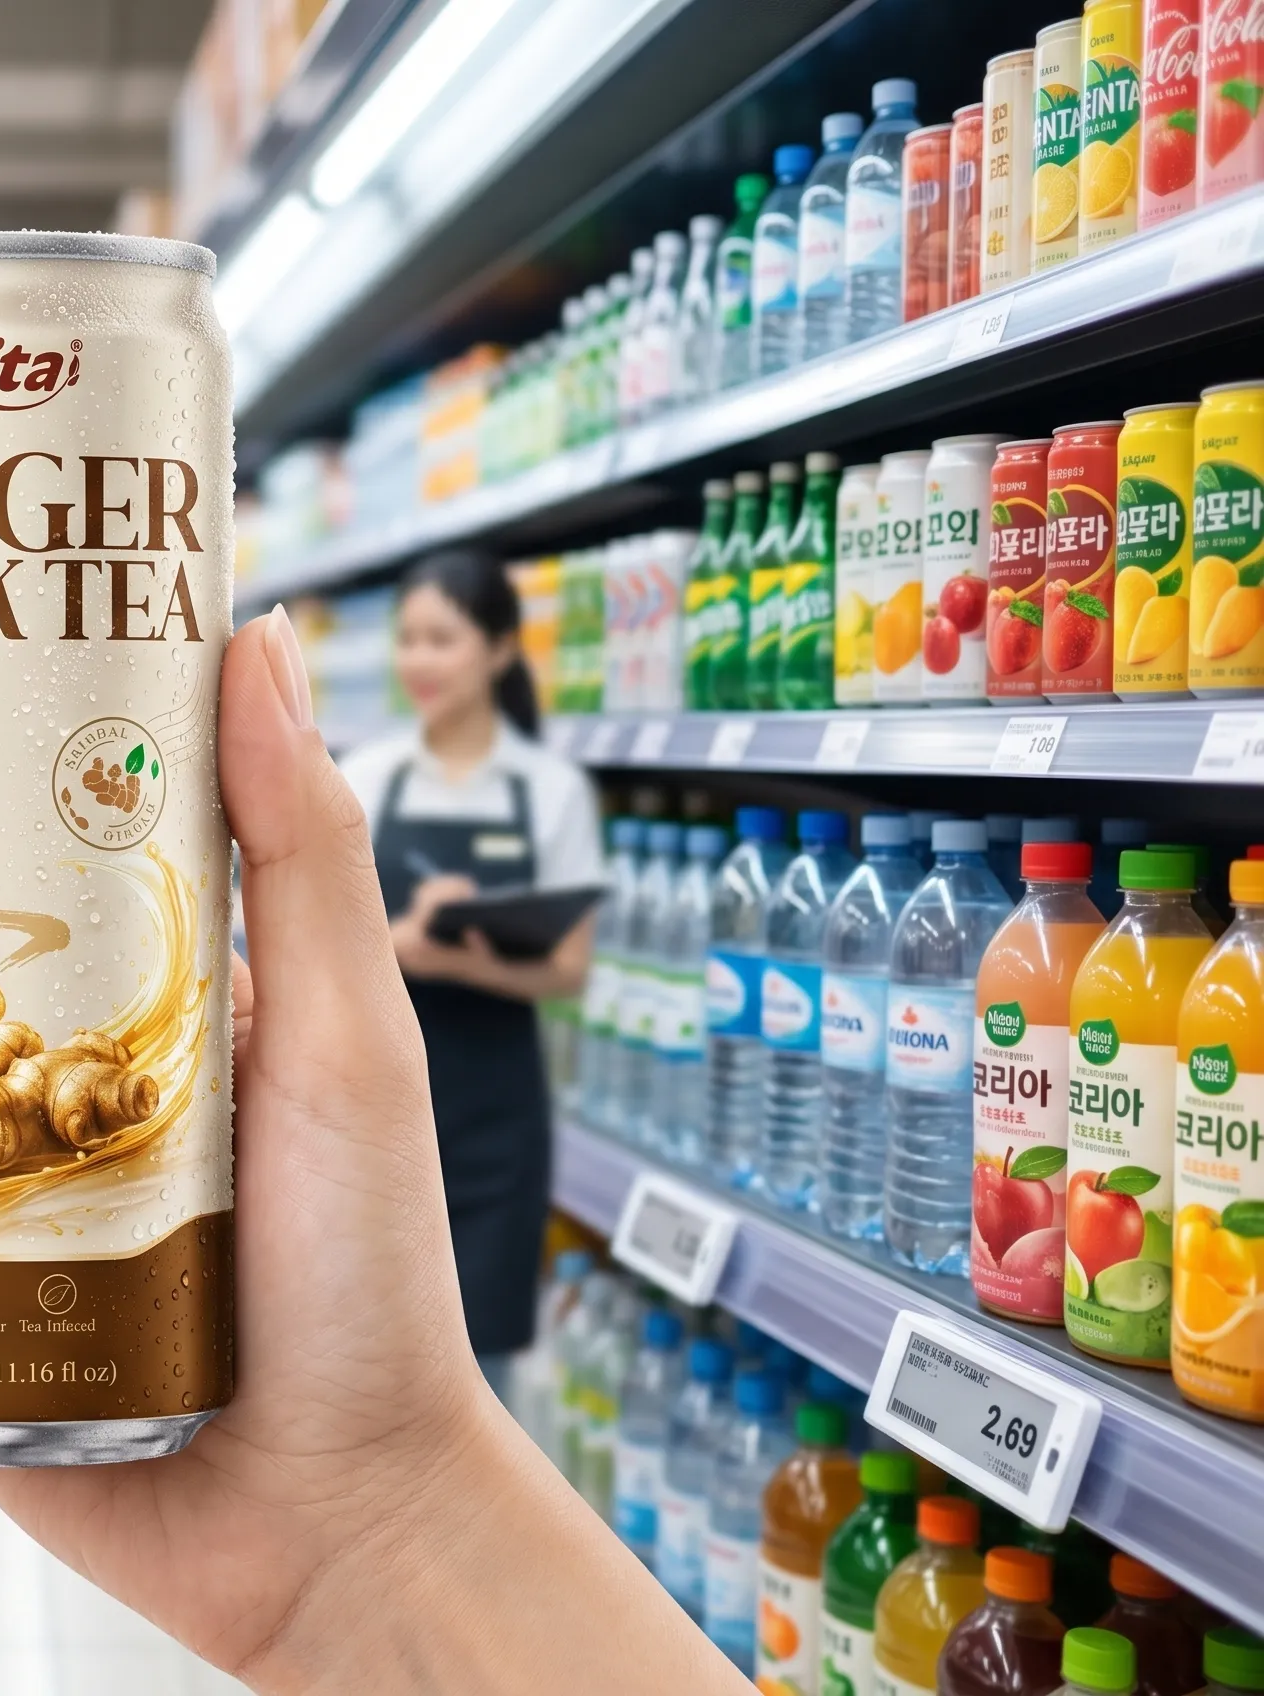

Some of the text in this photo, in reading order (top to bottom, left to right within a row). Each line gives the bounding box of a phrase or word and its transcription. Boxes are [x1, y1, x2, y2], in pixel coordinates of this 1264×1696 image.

[44, 559, 204, 642] TEA
[973, 1061, 1053, 1108] 코리아
[1068, 1079, 1145, 1127] 코리아
[1176, 1110, 1264, 1162] 코리아
[19, 1319, 42, 1332] Tea
[61, 1361, 77, 1382] fl
[83, 1359, 118, 1387] oz)
[980, 1404, 1038, 1459] 2,69
